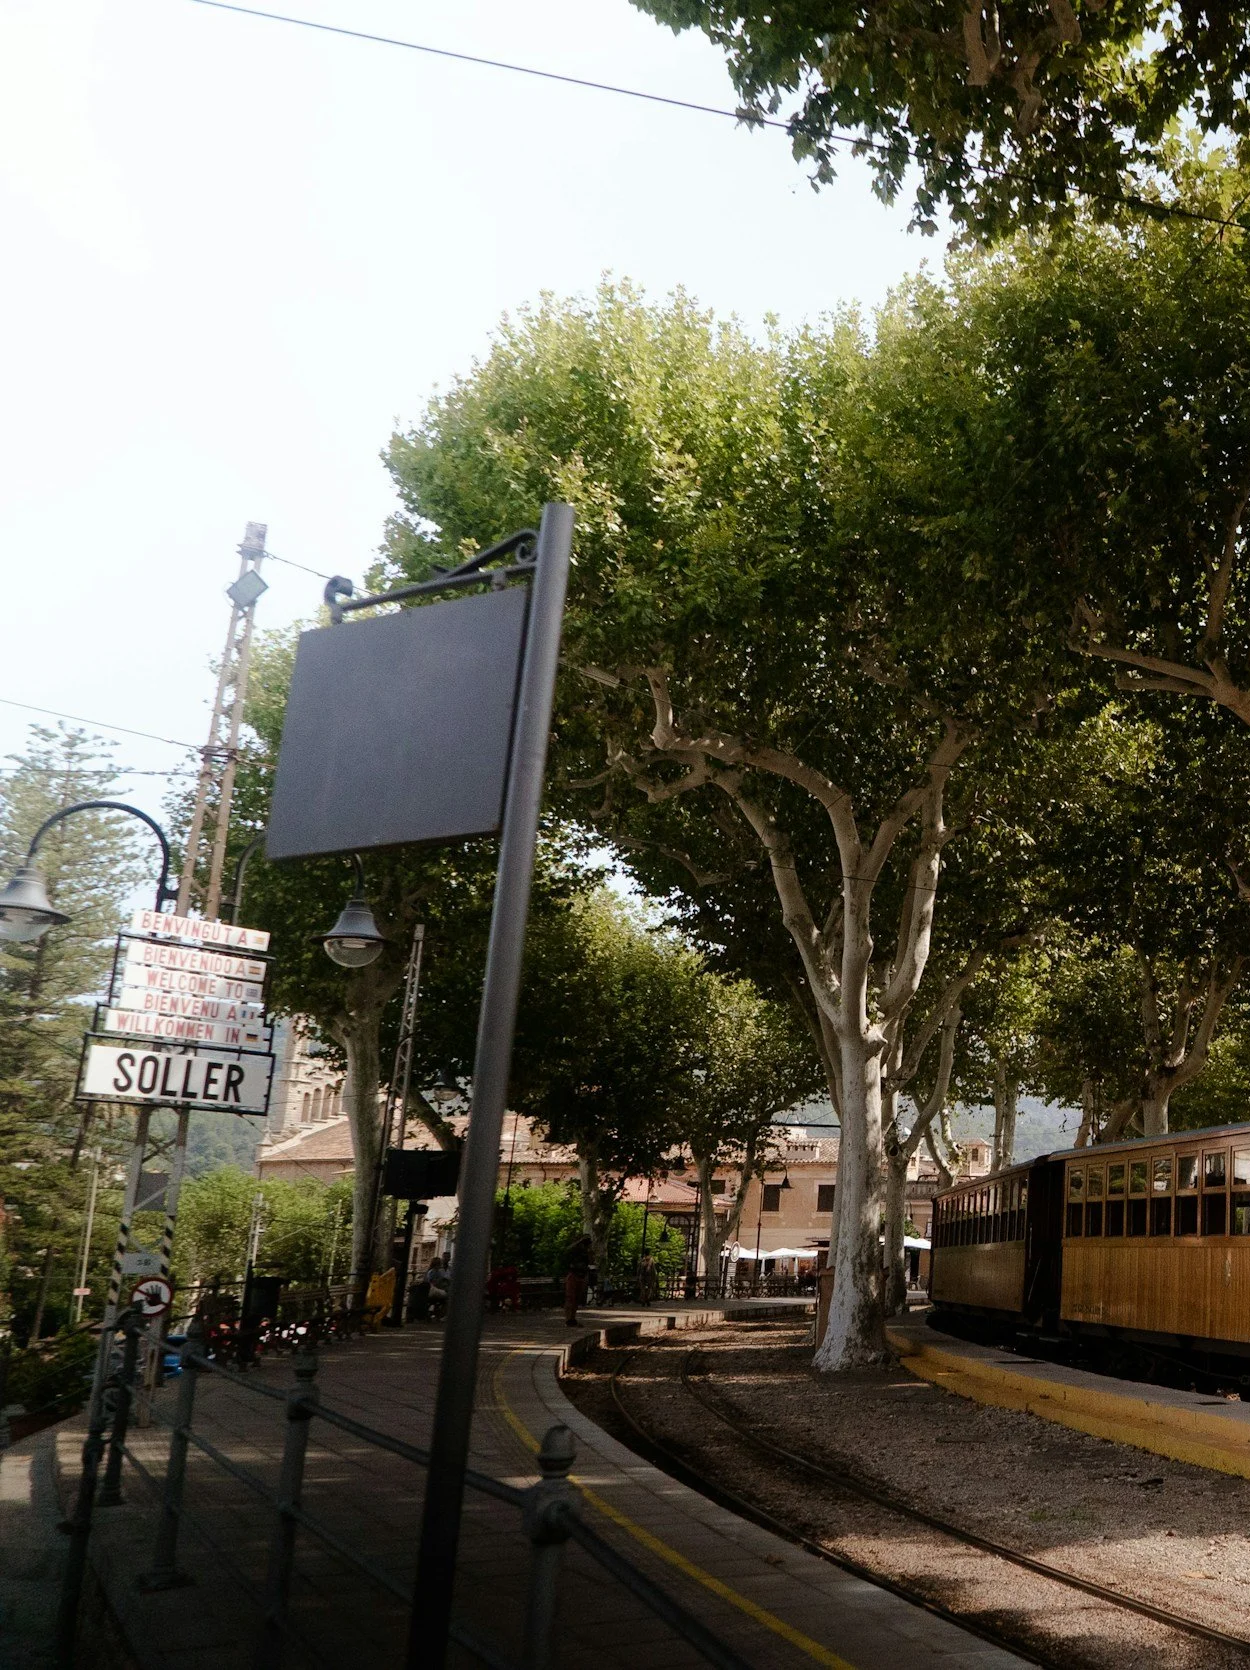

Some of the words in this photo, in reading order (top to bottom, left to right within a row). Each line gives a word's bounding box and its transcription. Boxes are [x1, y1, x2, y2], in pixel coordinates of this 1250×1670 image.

[141, 912, 233, 943] BENVINGUT
[237, 931, 247, 945] A
[143, 946, 232, 975] BIENVENIDO
[235, 960, 246, 977] A
[147, 969, 216, 995] WELCOME
[225, 981, 243, 999] TO
[144, 993, 220, 1019] BIENVENU
[226, 1005, 237, 1021] A
[116, 1016, 214, 1040] WILLKOMMEN
[225, 1027, 240, 1043] IN
[113, 1052, 245, 1102] SOLLER
